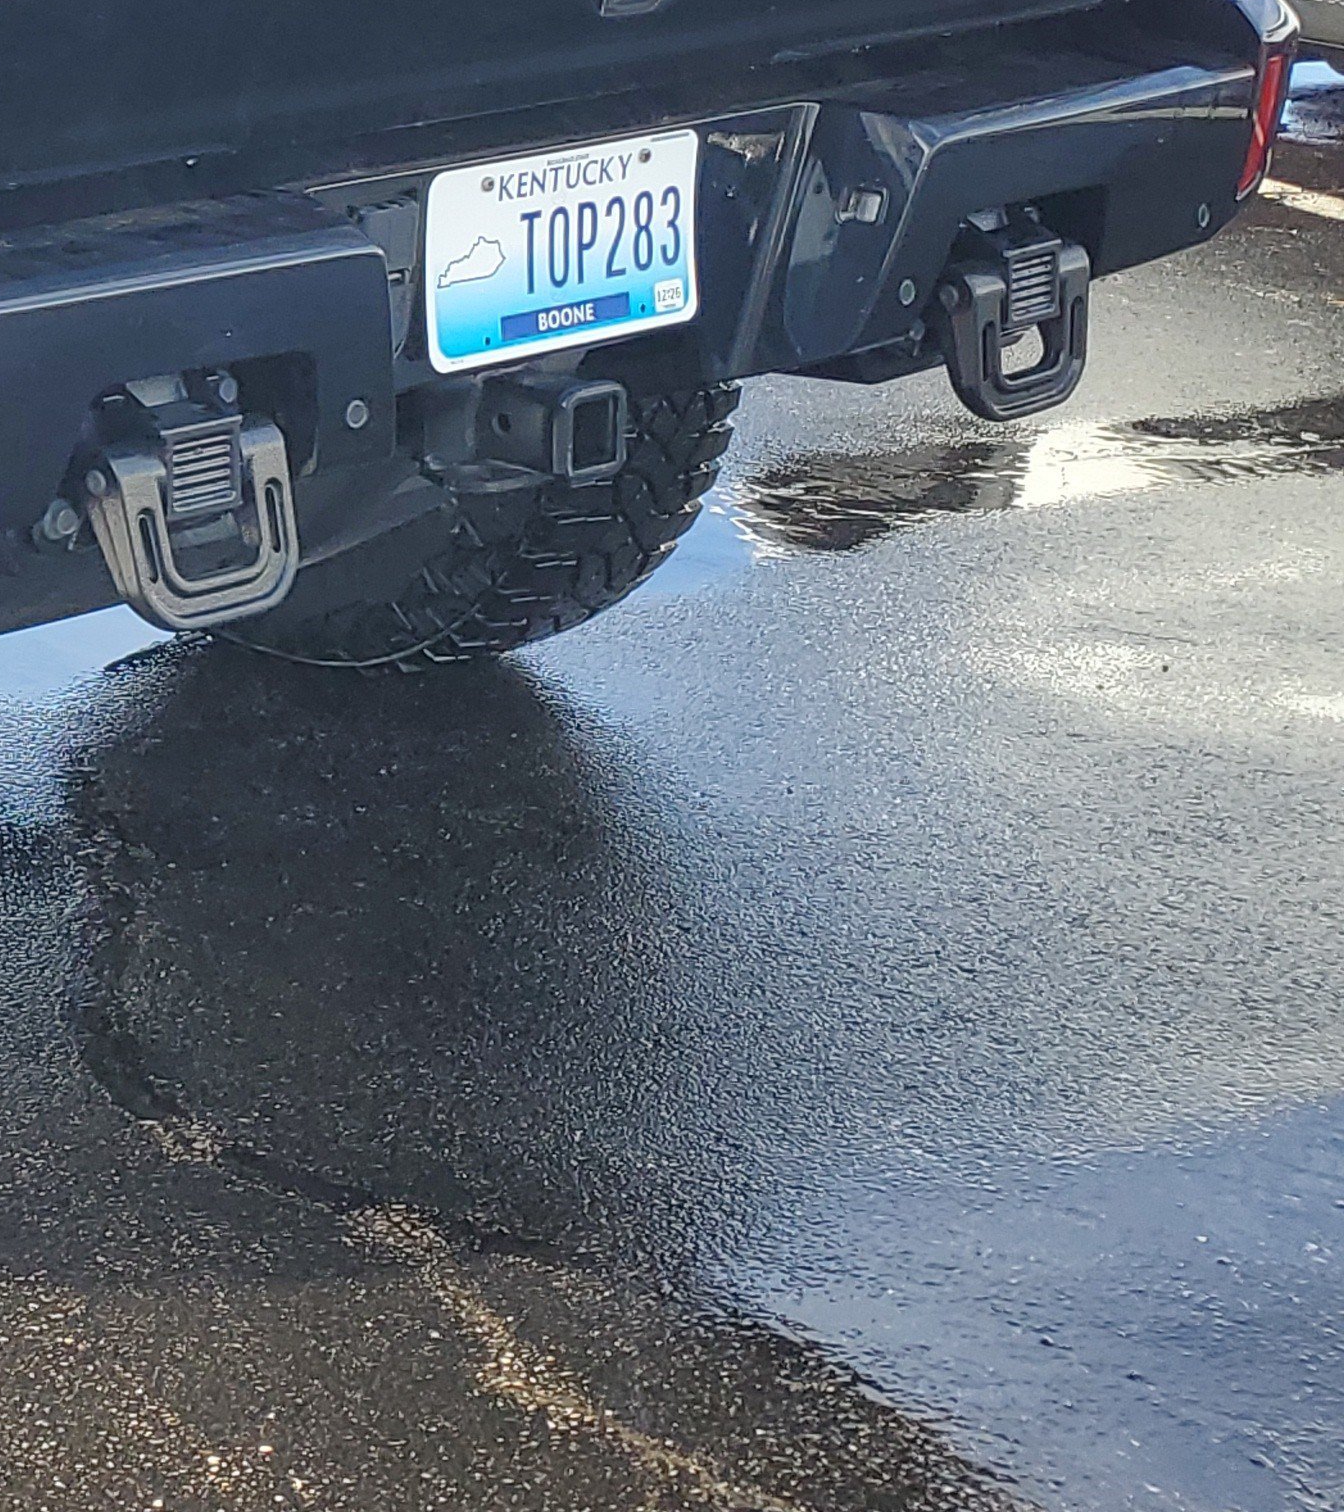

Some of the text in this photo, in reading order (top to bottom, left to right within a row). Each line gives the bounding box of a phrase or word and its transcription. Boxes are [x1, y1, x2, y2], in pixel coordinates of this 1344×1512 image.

[497, 152, 633, 202] KENTUCKY
[519, 185, 682, 295] TOP283
[538, 303, 596, 332] BOONE
